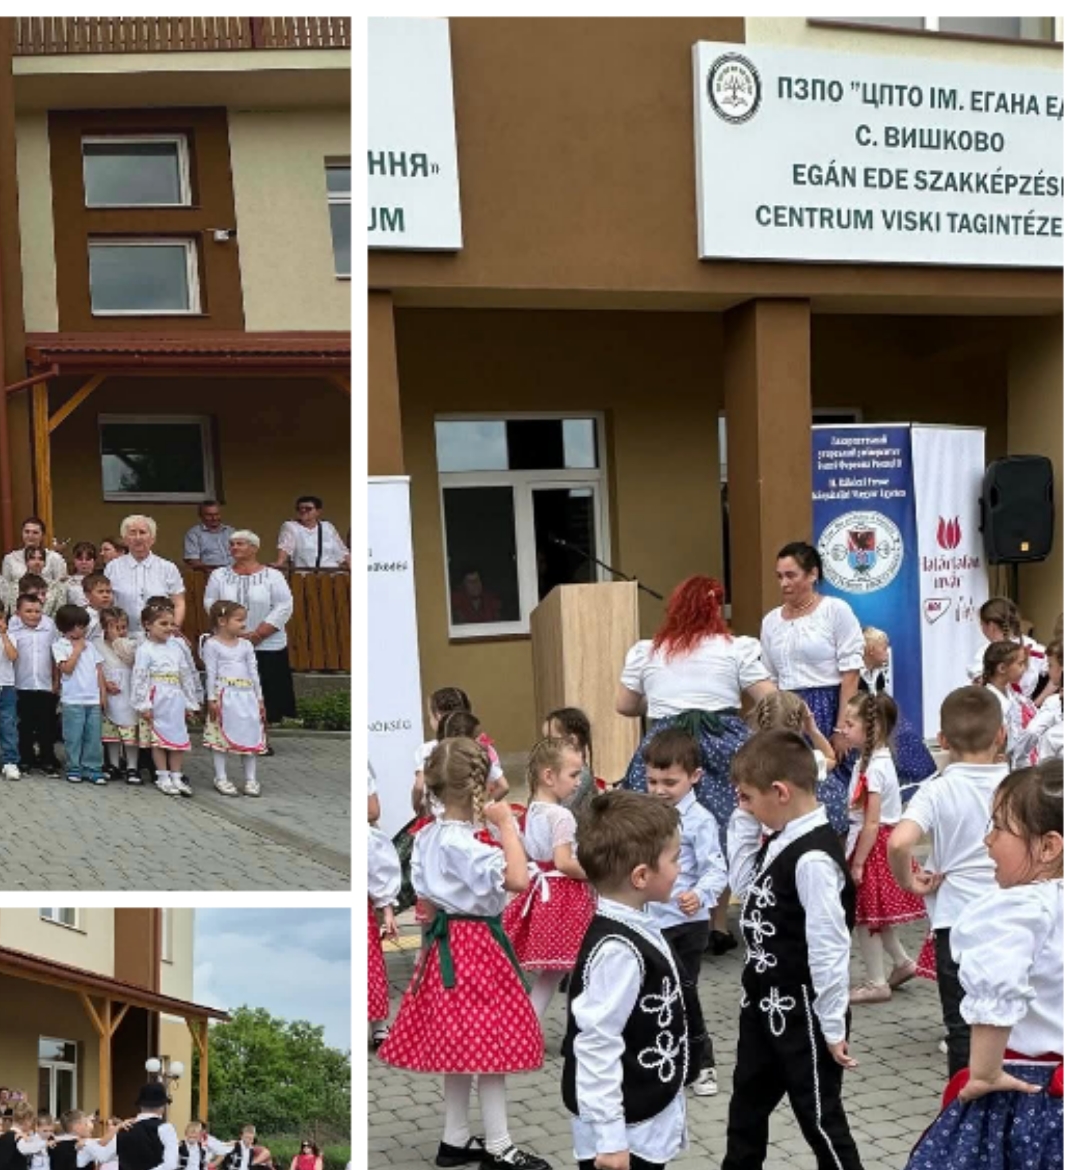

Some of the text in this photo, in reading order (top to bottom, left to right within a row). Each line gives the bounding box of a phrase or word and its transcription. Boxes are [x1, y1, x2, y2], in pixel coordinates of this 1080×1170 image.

[778, 76, 844, 102] ПЗПО
[930, 87, 965, 111] ІМ.
[970, 91, 1040, 116] ЕГАНА
[855, 124, 1005, 152] С. ВИШКОВО
[793, 160, 1064, 197] EGÁN EDE SZAKKÉPZÉSI
[755, 204, 874, 230] CENTRUM
[881, 209, 941, 233] VISKI
